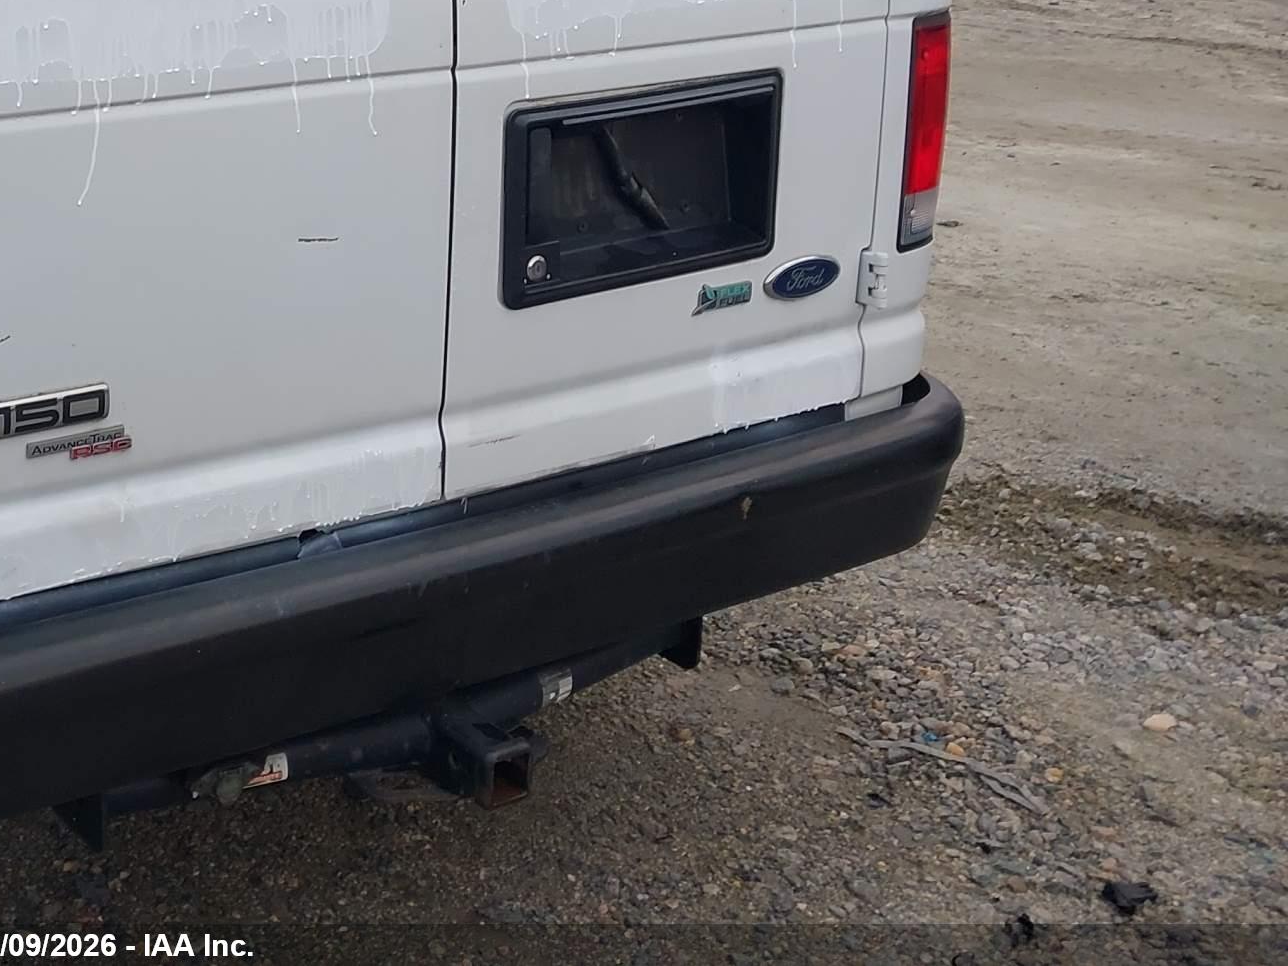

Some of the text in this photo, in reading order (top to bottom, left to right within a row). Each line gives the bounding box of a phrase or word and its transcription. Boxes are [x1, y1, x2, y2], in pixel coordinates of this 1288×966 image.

[720, 284, 750, 298] FLEX
[787, 266, 825, 292] Ford
[70, 436, 132, 460] RSC
